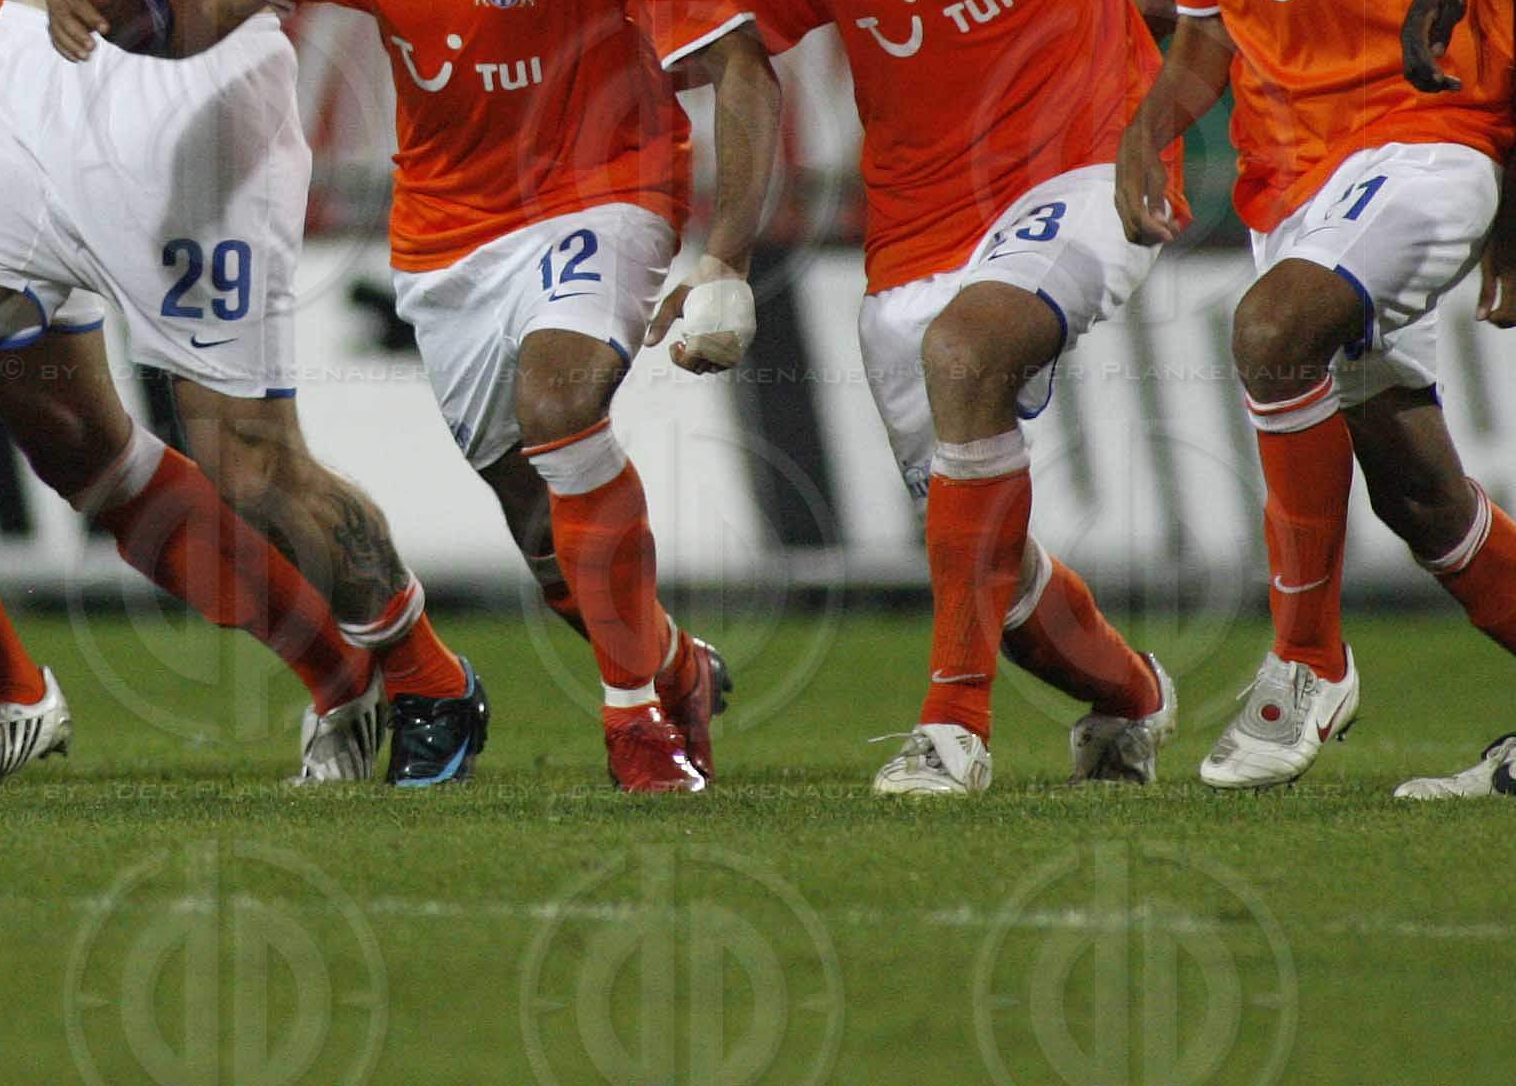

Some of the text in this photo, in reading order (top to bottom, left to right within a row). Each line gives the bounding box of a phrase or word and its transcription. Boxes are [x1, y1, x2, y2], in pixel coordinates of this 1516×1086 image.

[476, 56, 543, 92] TUI
[1326, 176, 1388, 221] 1
[993, 202, 1066, 248] 3
[161, 239, 252, 320] 29
[537, 229, 601, 291] 12
